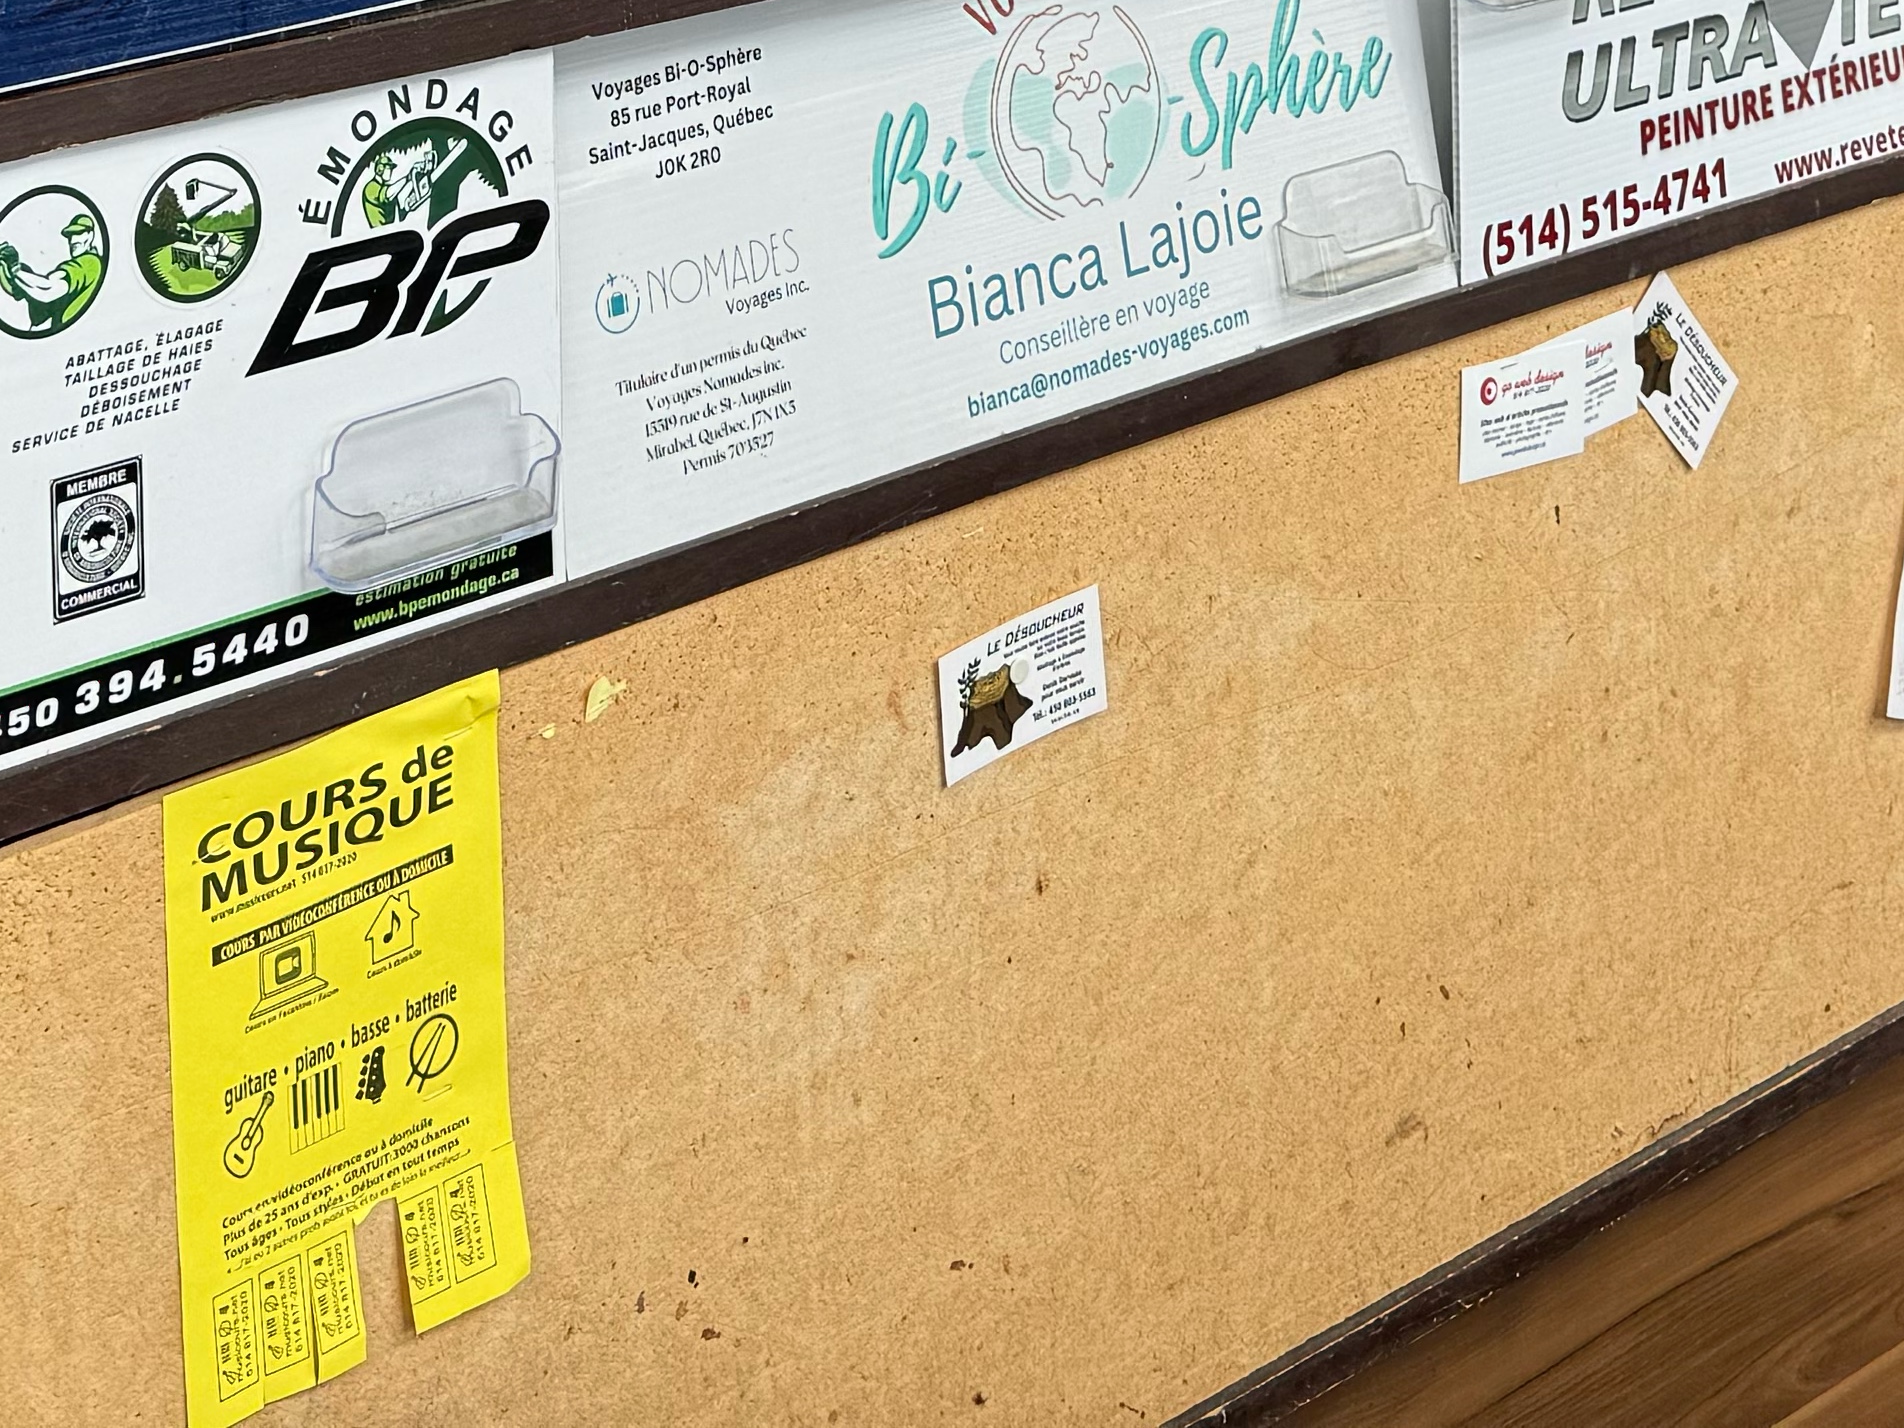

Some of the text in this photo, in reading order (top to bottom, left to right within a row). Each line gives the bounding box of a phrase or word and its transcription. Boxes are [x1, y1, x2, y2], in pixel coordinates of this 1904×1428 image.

[592, 46, 763, 101] Voyages Bi-O-Sphère
[1561, 0, 1778, 124] ULTRA
[589, 103, 774, 165] Saint-Jacques, Québec
[611, 76, 751, 128] 85 rue Port-Royal
[1640, 85, 1774, 156] PEINTURE
[299, 78, 535, 226] ÉMONDAGE
[1482, 158, 1728, 277] (514) 515-4741
[244, 198, 551, 378] BP
[647, 228, 799, 314] NOMADES
[928, 186, 1264, 339] Bianca Lajoie
[726, 279, 810, 315] Voyages Inc.
[1000, 280, 1210, 366] Conseillère en voyage
[64, 339, 213, 388] TAILLAGE DE HAIES
[65, 317, 224, 370] ABATTAGE, ÉLAGAGE
[967, 307, 1250, 418] bianca@nomades-voyages.com
[80, 378, 193, 419] DÉBOISEMENT
[88, 359, 203, 399] DESSOUCHAGE
[12, 398, 181, 454] SERVICE DE NACELLE
[66, 467, 127, 496] MEMBRE
[61, 578, 138, 609] COMMERCIAL
[353, 567, 520, 632] www.bpemondage.ca
[354, 544, 518, 607] estimation gratuite
[987, 639, 1001, 657] LE
[1005, 602, 1084, 647] DÉSOUCHEUR
[75, 614, 310, 715] 394.5440
[197, 744, 454, 864] COURS de
[202, 772, 454, 912] MUSIQUE
[220, 850, 448, 960] COURS PAR VIDÉOCONFÉRENCE OU DOMICILE
[224, 981, 458, 1115] guitare piano basse batterie
